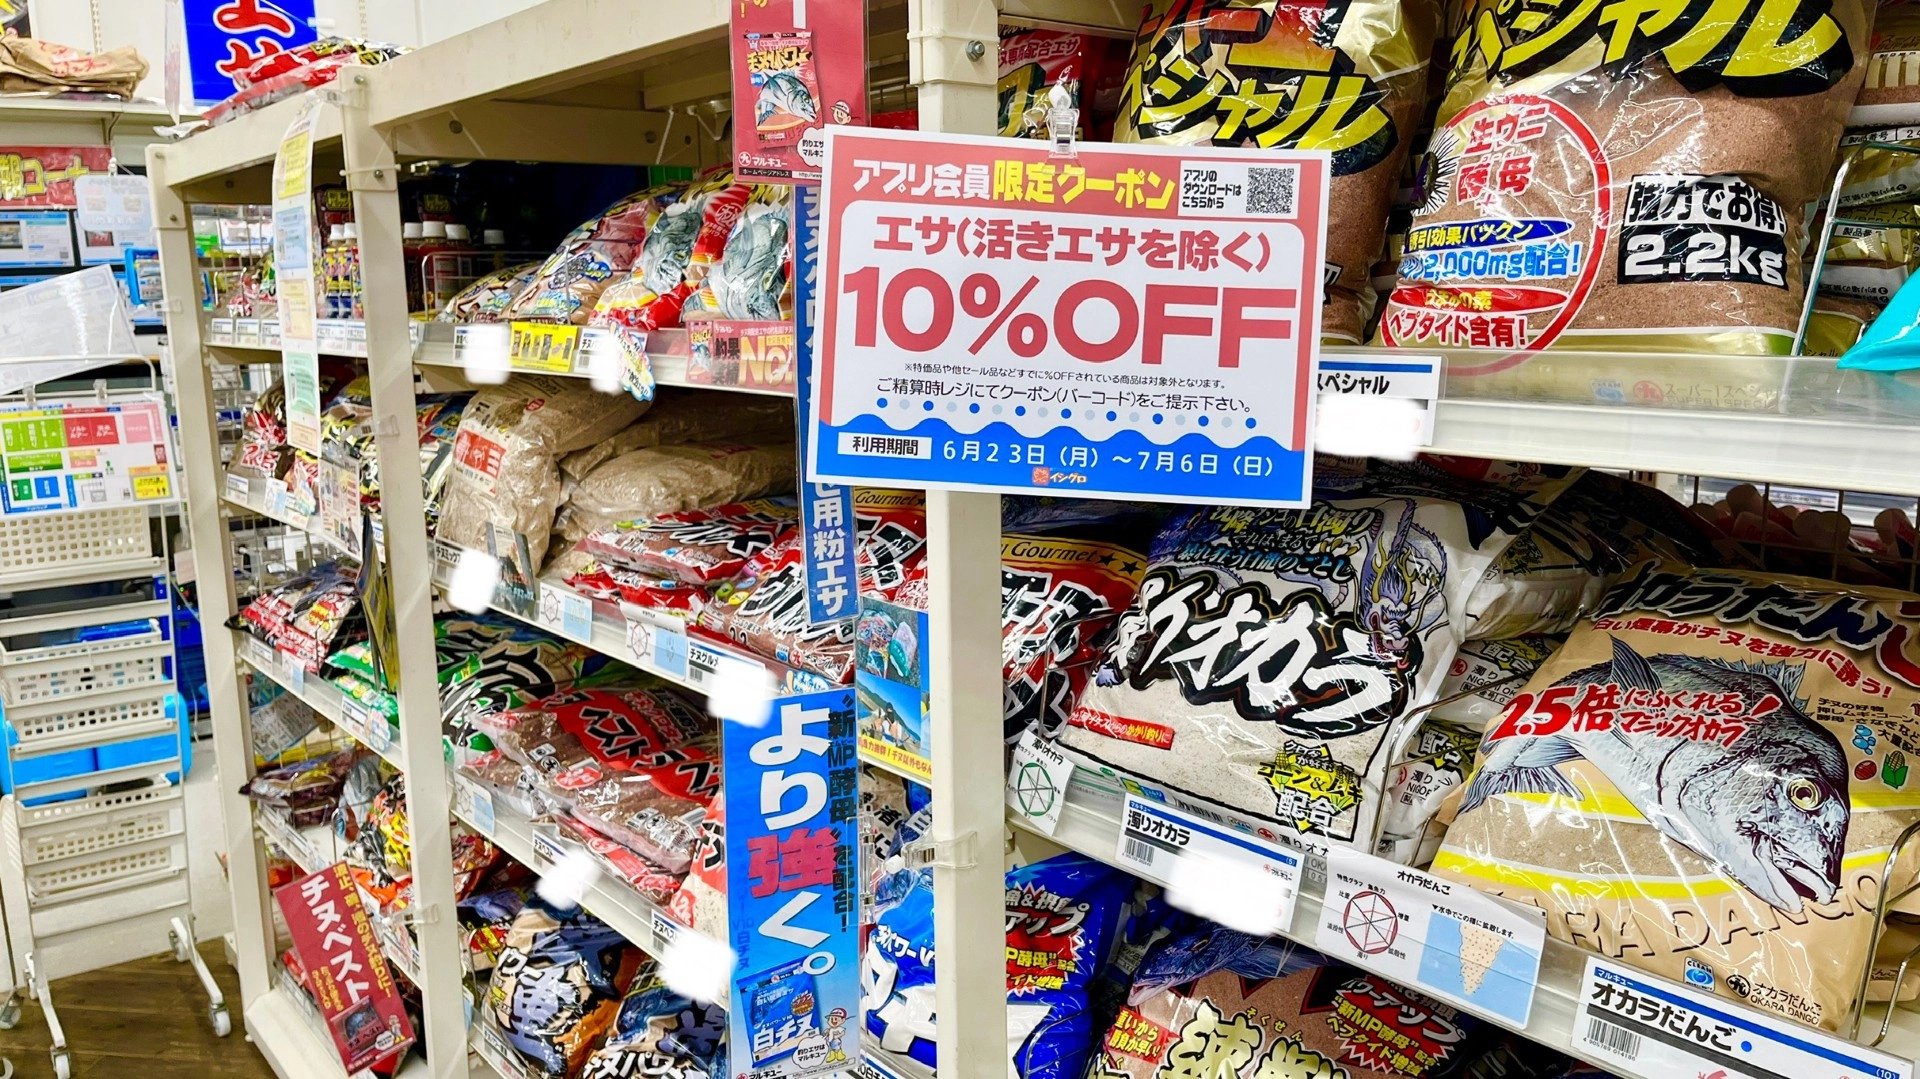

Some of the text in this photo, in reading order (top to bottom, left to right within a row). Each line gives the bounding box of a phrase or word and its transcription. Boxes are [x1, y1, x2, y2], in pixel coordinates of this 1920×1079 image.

[1464, 103, 1550, 155] 生ウニ
[853, 159, 1176, 211] アプリ会員限定クーポン
[1182, 182, 1242, 198] ダウンロードは
[1183, 168, 1218, 183] アプリの
[1456, 155, 1534, 205] 酵母
[1182, 195, 1225, 209] こちらから
[1629, 175, 1787, 233] 強力でお得!
[872, 215, 1271, 274] エサ(活きエサを除く)
[1625, 233, 1787, 287] 2.2kg
[842, 266, 1297, 369] 10%OFF
[1389, 310, 1528, 347] ペプタイド含有!
[852, 436, 919, 457] 利用期間
[1050, 471, 1088, 486] イシグロ
[855, 490, 915, 507] Gourmet
[1011, 541, 1100, 563] Gourmet
[1818, 698, 1885, 713] チヌの好物
[1031, 737, 1065, 766] 濁りオカラ
[1127, 809, 1191, 846] 濁りオカラ
[1276, 790, 1337, 828] 配合
[748, 703, 840, 976] より強く。
[1397, 869, 1451, 896] オカラだんご
[300, 874, 370, 1004] チヌベスト
[1596, 967, 1635, 987] マルキュー
[1114, 1009, 1160, 1042] 重いから
[1338, 977, 1468, 1045] パワーアップ
[1591, 981, 1737, 1054] オカラだんご
